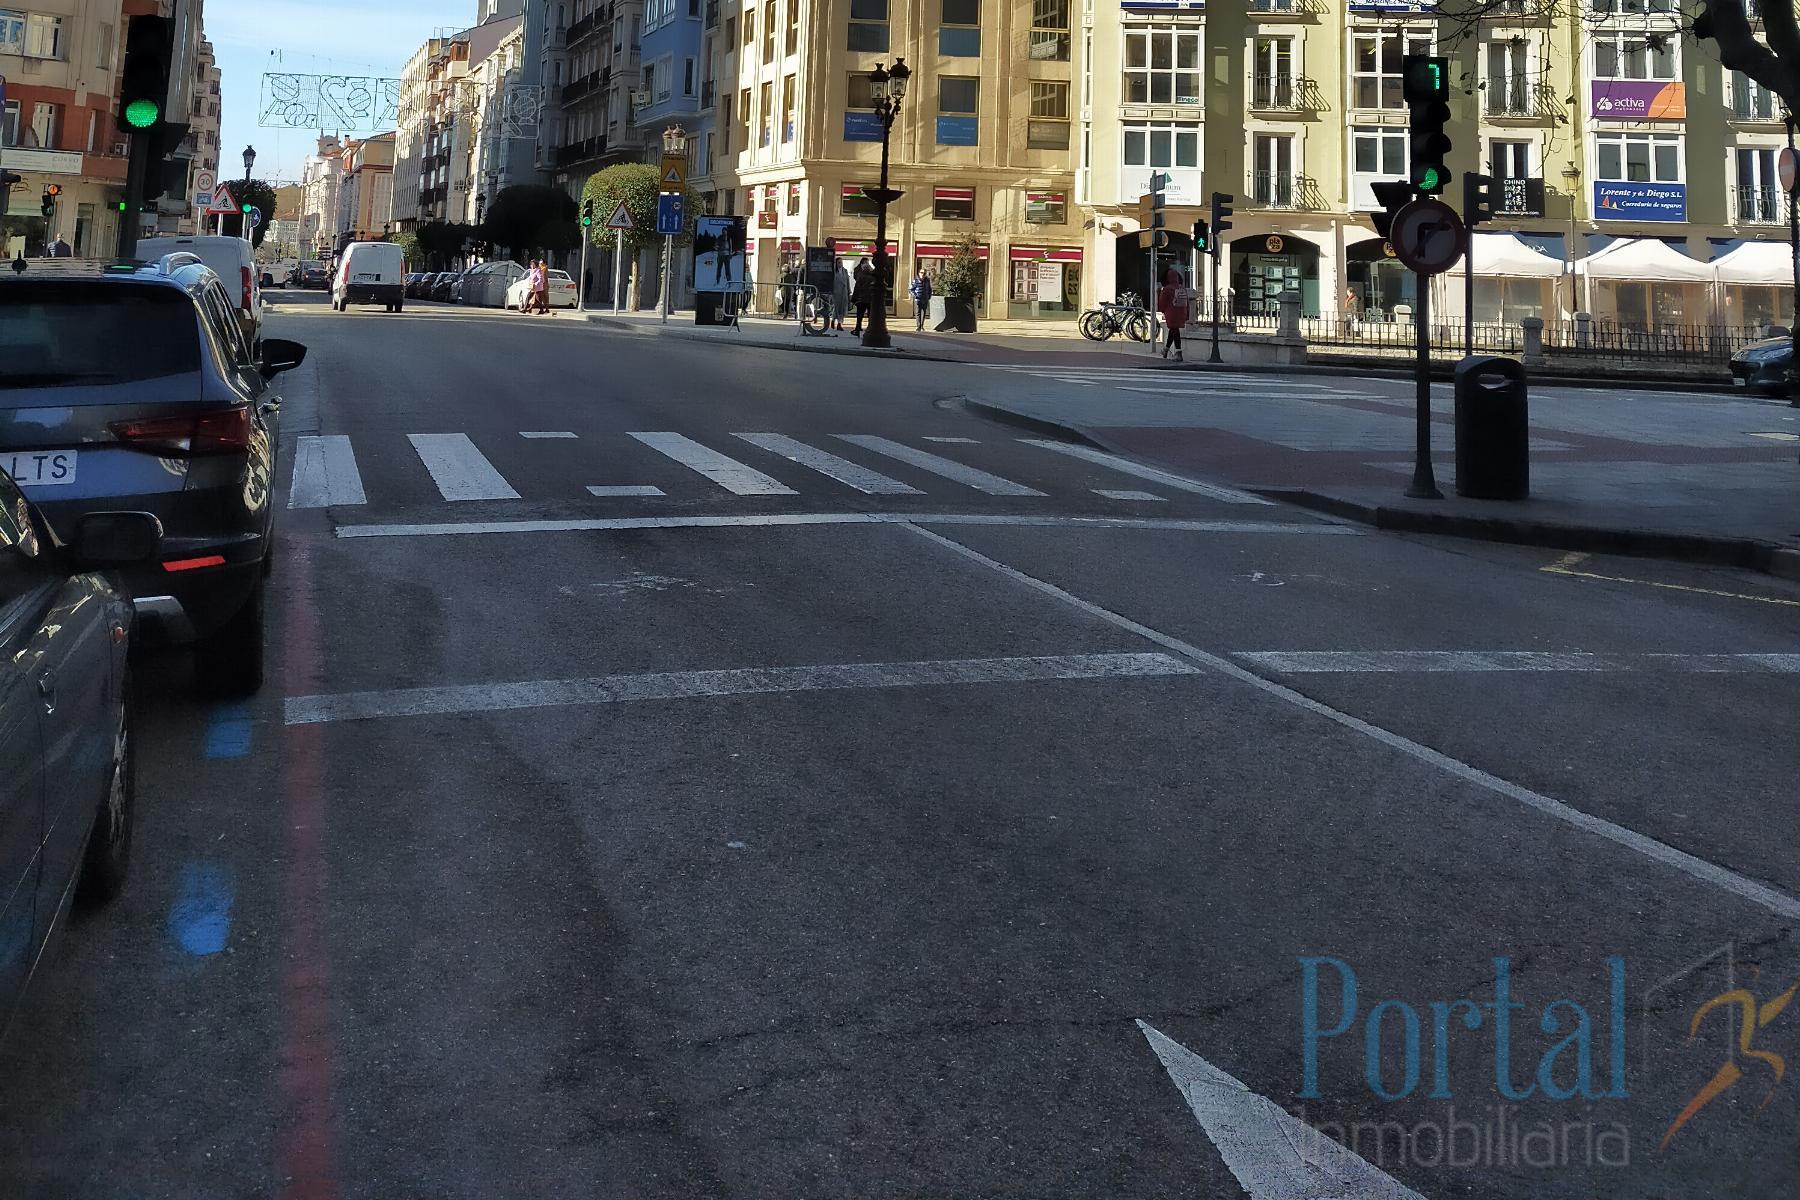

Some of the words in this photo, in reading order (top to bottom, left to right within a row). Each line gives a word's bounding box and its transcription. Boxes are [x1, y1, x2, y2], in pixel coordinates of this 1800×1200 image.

[1614, 97, 1645, 108] activa
[1600, 187, 1632, 196] Lorente
[1646, 189, 1670, 199] Diego
[11, 454, 68, 481] LTS
